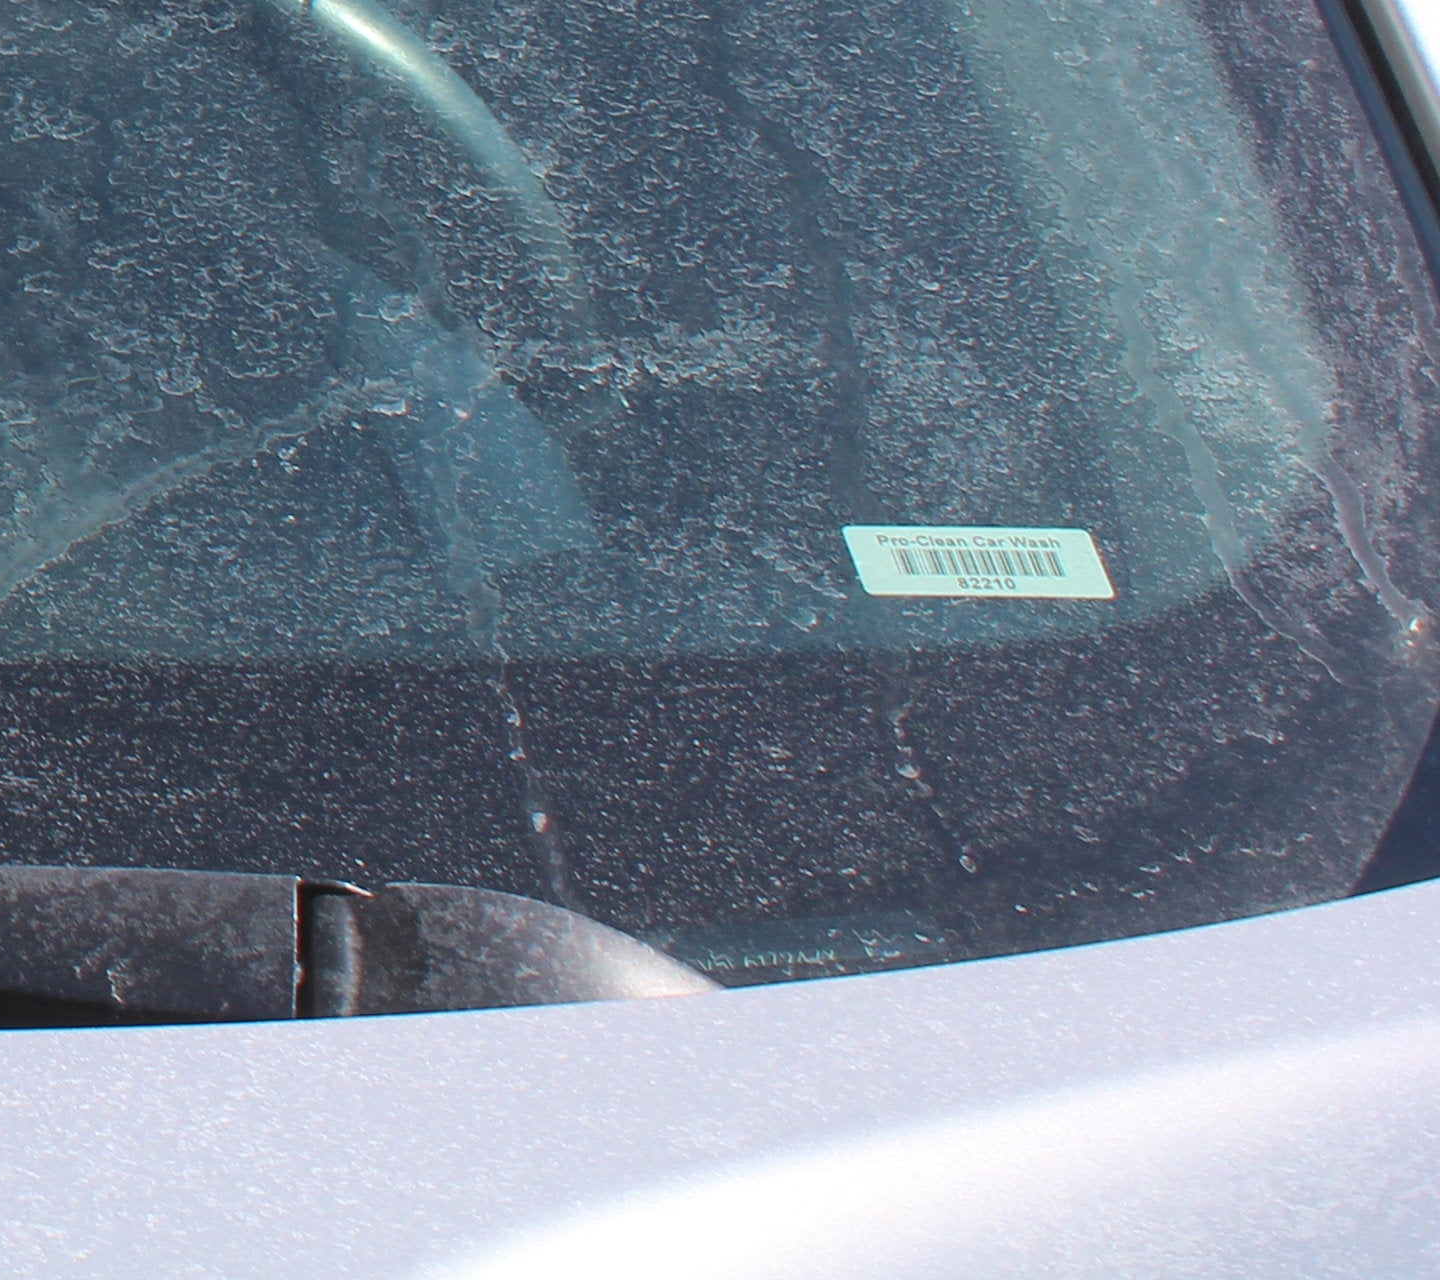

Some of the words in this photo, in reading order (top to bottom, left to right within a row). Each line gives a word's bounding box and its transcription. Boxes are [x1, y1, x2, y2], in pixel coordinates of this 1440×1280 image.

[876, 534, 968, 548] Pro-Clean
[972, 535, 1005, 548] Car
[1010, 535, 1061, 550] Wash
[957, 577, 1016, 590] 82210
